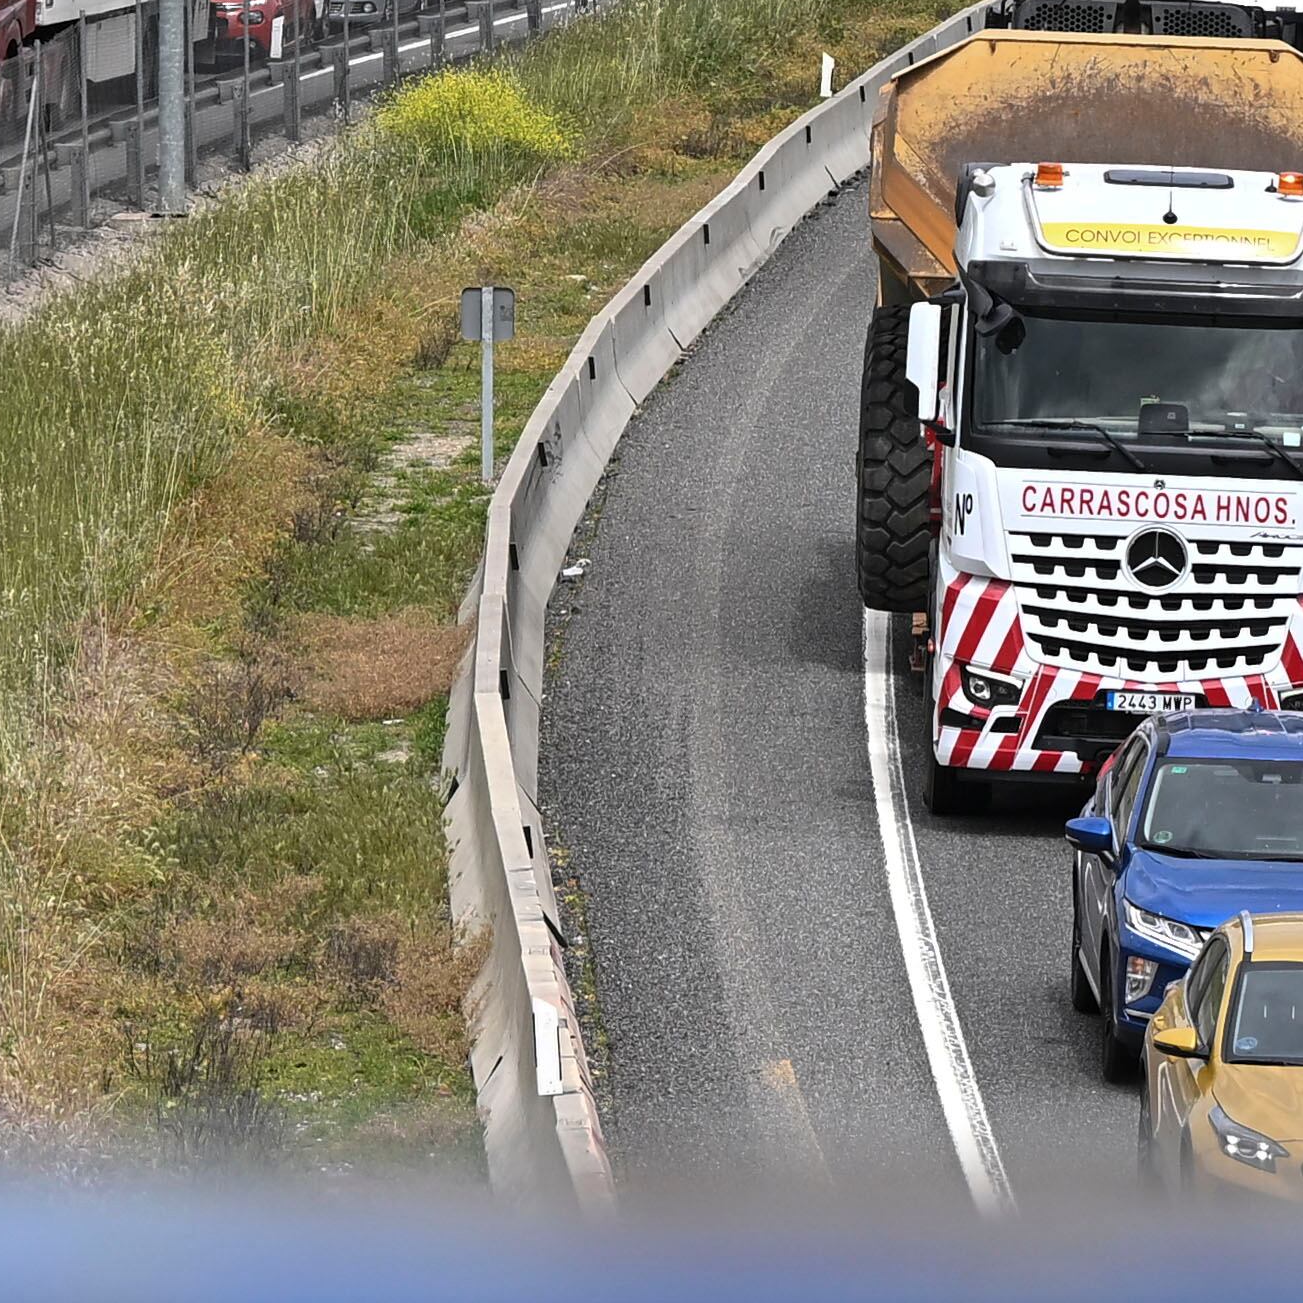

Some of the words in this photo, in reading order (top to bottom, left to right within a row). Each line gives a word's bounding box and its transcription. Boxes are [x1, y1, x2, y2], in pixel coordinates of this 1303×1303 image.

[1065, 228, 1141, 244] CONVOI
[1022, 485, 1207, 522] CARRASCOSA
[1216, 495, 1296, 525] HNOS.
[1117, 694, 1157, 710] 2443
